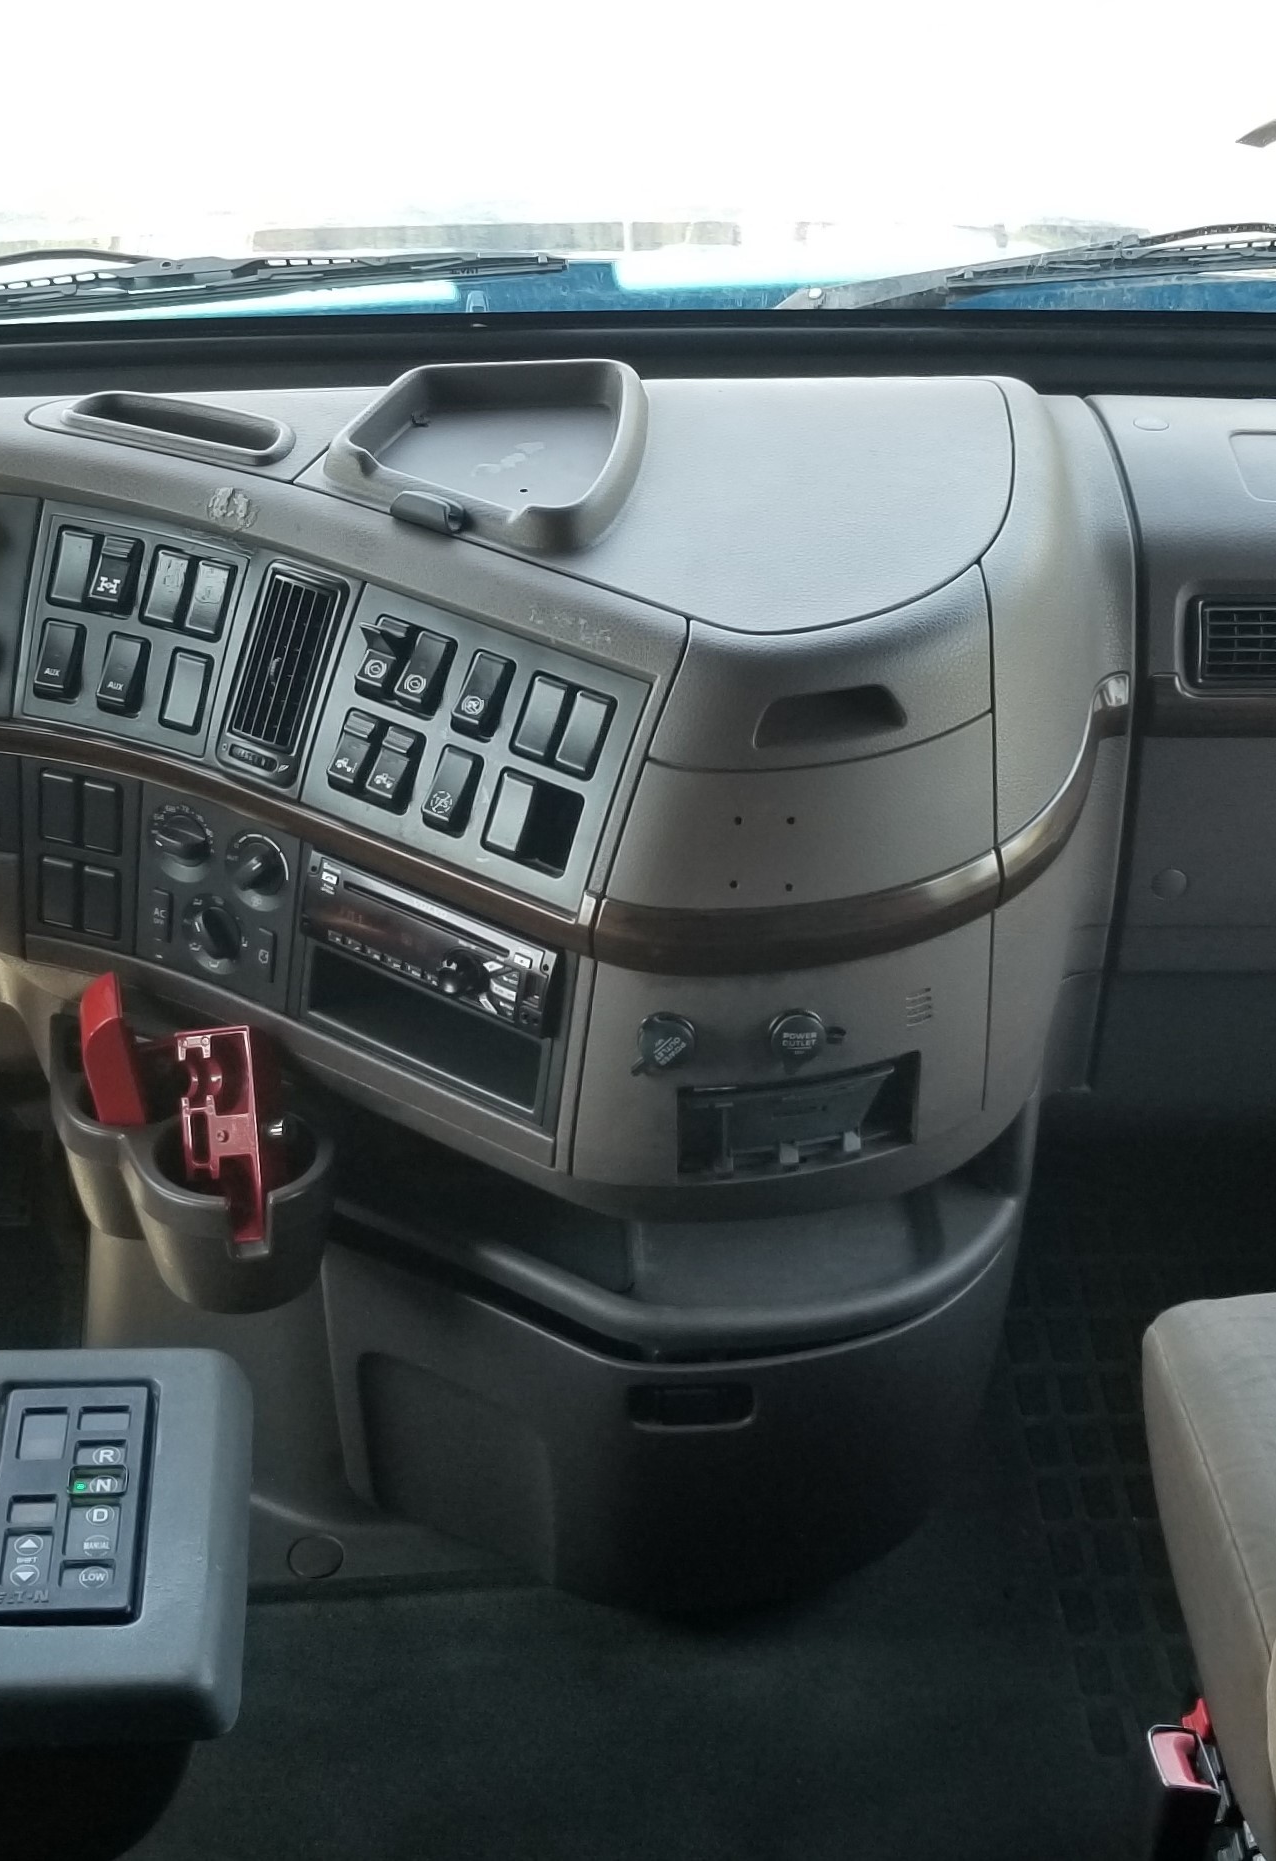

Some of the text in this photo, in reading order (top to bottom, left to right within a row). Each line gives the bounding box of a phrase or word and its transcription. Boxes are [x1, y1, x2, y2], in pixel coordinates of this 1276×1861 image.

[44, 667, 61, 677] AUX
[107, 680, 124, 691] AUX
[153, 907, 167, 919] AC
[783, 1032, 817, 1040] POWER
[654, 1036, 681, 1061] OUTLET
[782, 1039, 816, 1047] OUTLET
[659, 1041, 687, 1066] POWER
[98, 1450, 115, 1463] R
[95, 1478, 112, 1492] N
[92, 1508, 108, 1522] D
[83, 1541, 110, 1550] MANUAL
[16, 1556, 38, 1564] SHIFT
[82, 1572, 106, 1582] LOW
